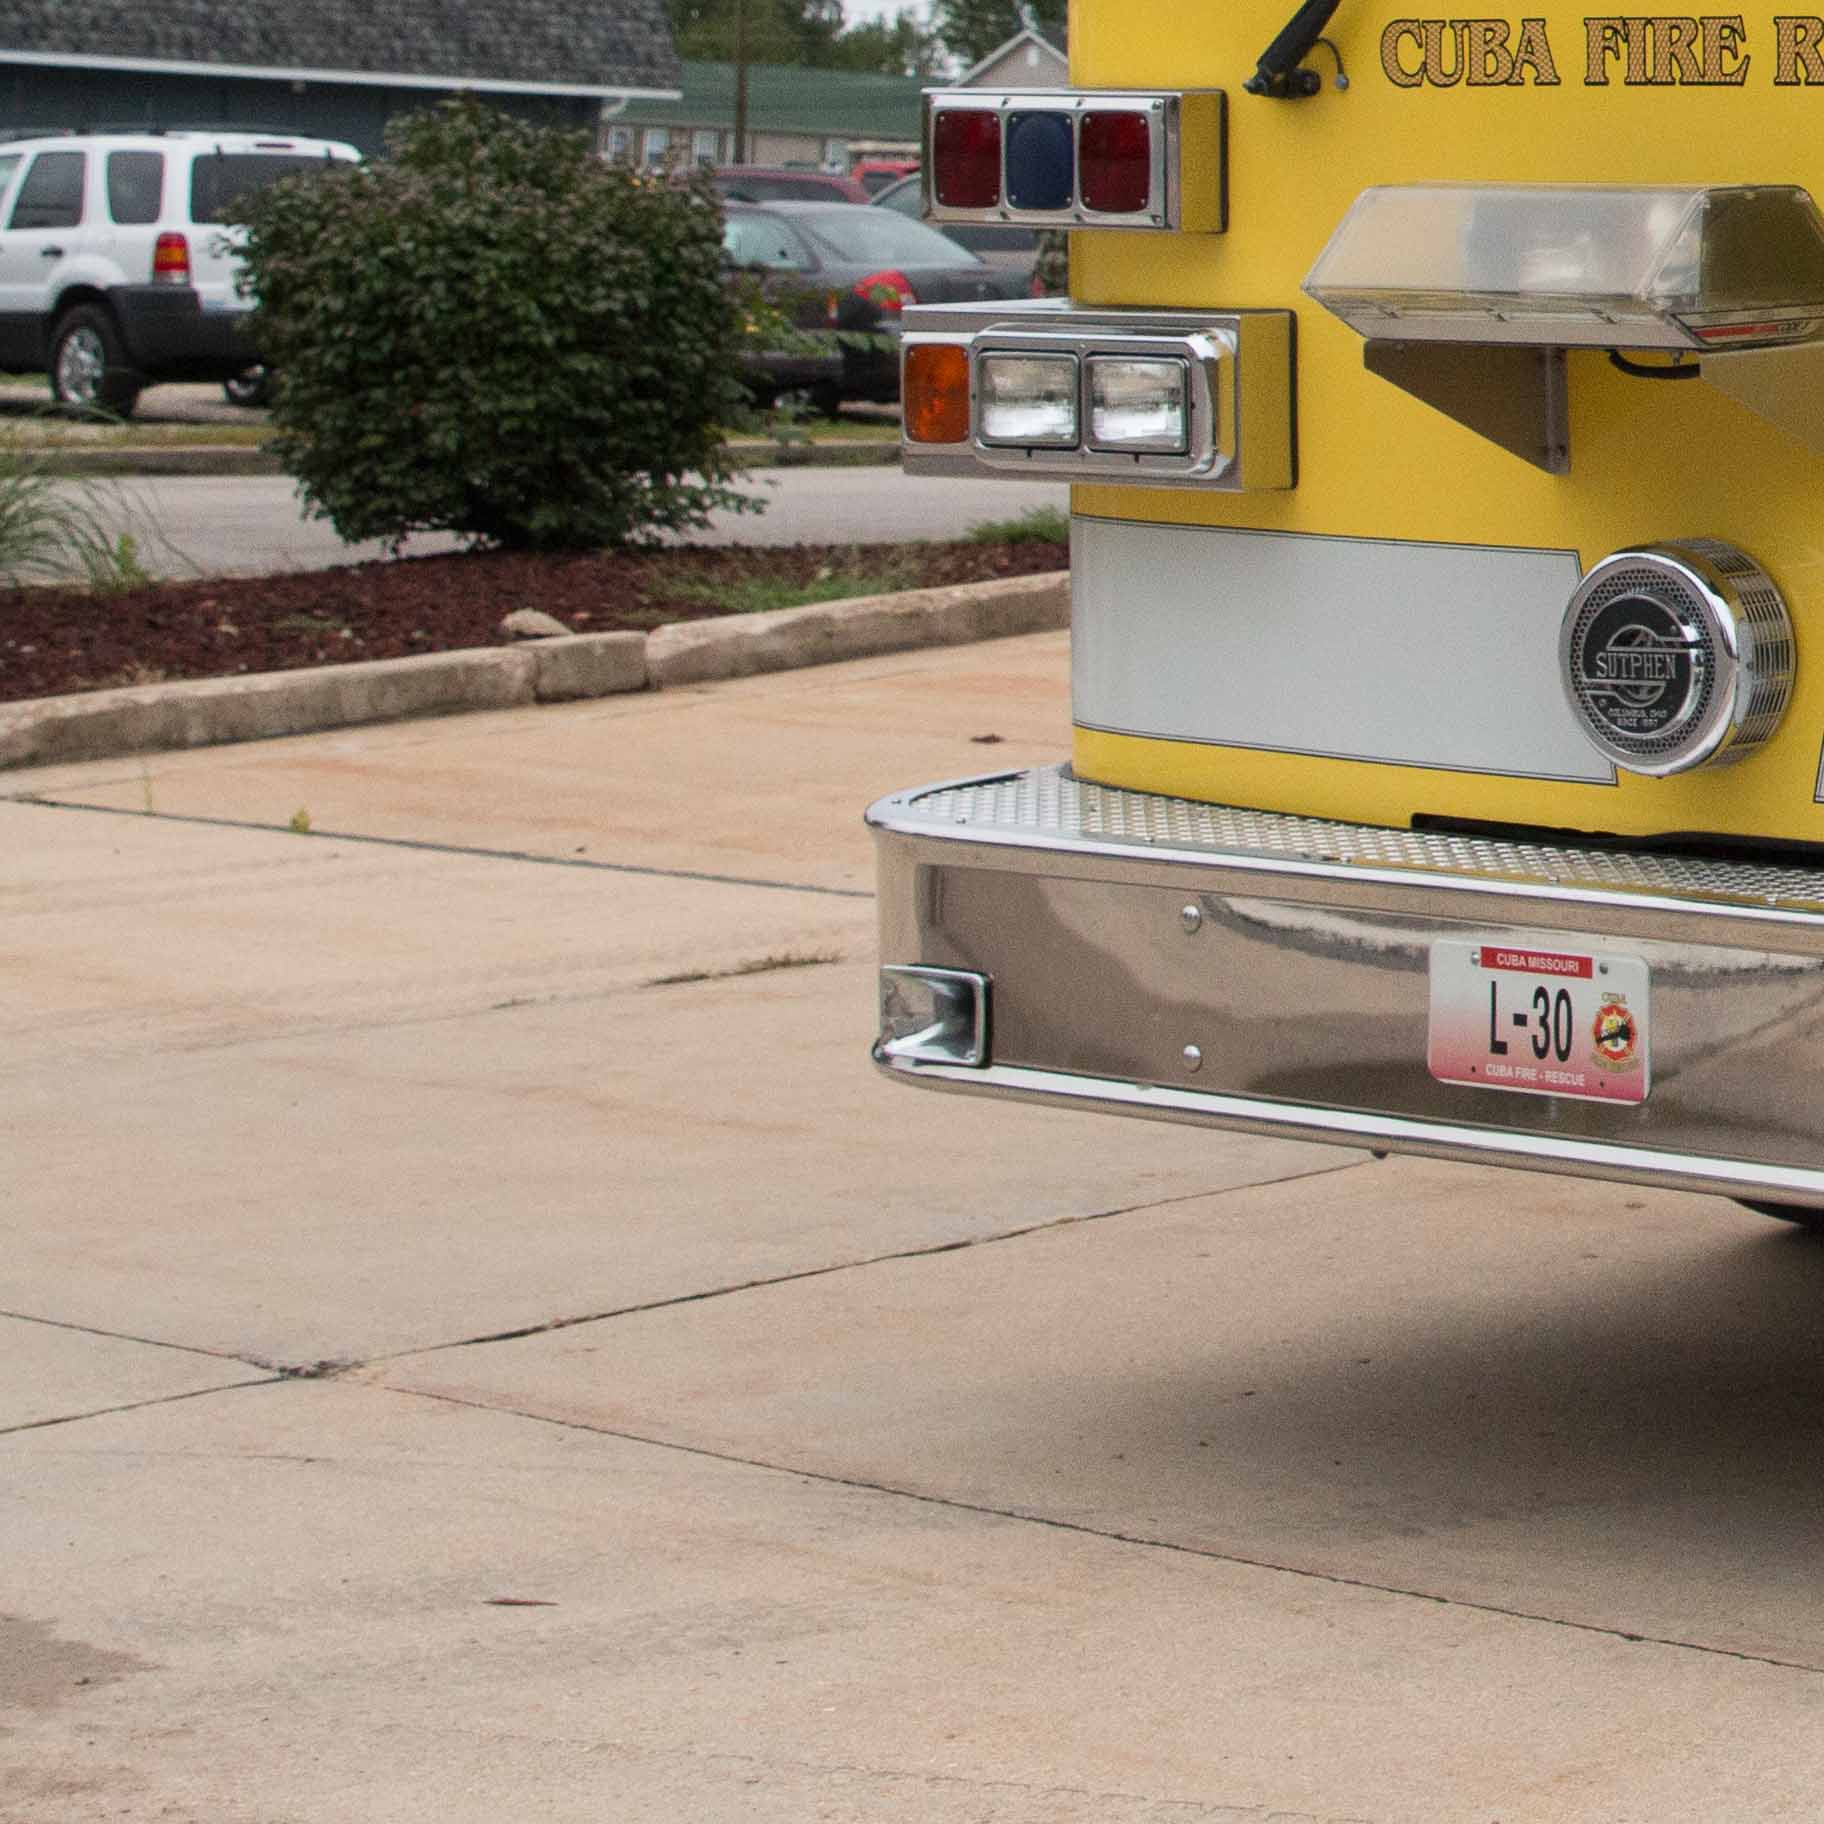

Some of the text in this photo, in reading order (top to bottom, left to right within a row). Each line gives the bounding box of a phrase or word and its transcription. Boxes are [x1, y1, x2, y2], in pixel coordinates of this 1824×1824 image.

[1380, 17, 1561, 88] CUBA
[1583, 15, 1751, 88] FIRE
[1595, 651, 1677, 680] SUTPHEN
[1496, 952, 1579, 973] CUBA MISSOURI
[1490, 980, 1573, 1063] L-30
[1486, 1063, 1513, 1079] CUBA
[1515, 1066, 1537, 1081] FIRE
[1544, 1070, 1585, 1087] RESCUE
